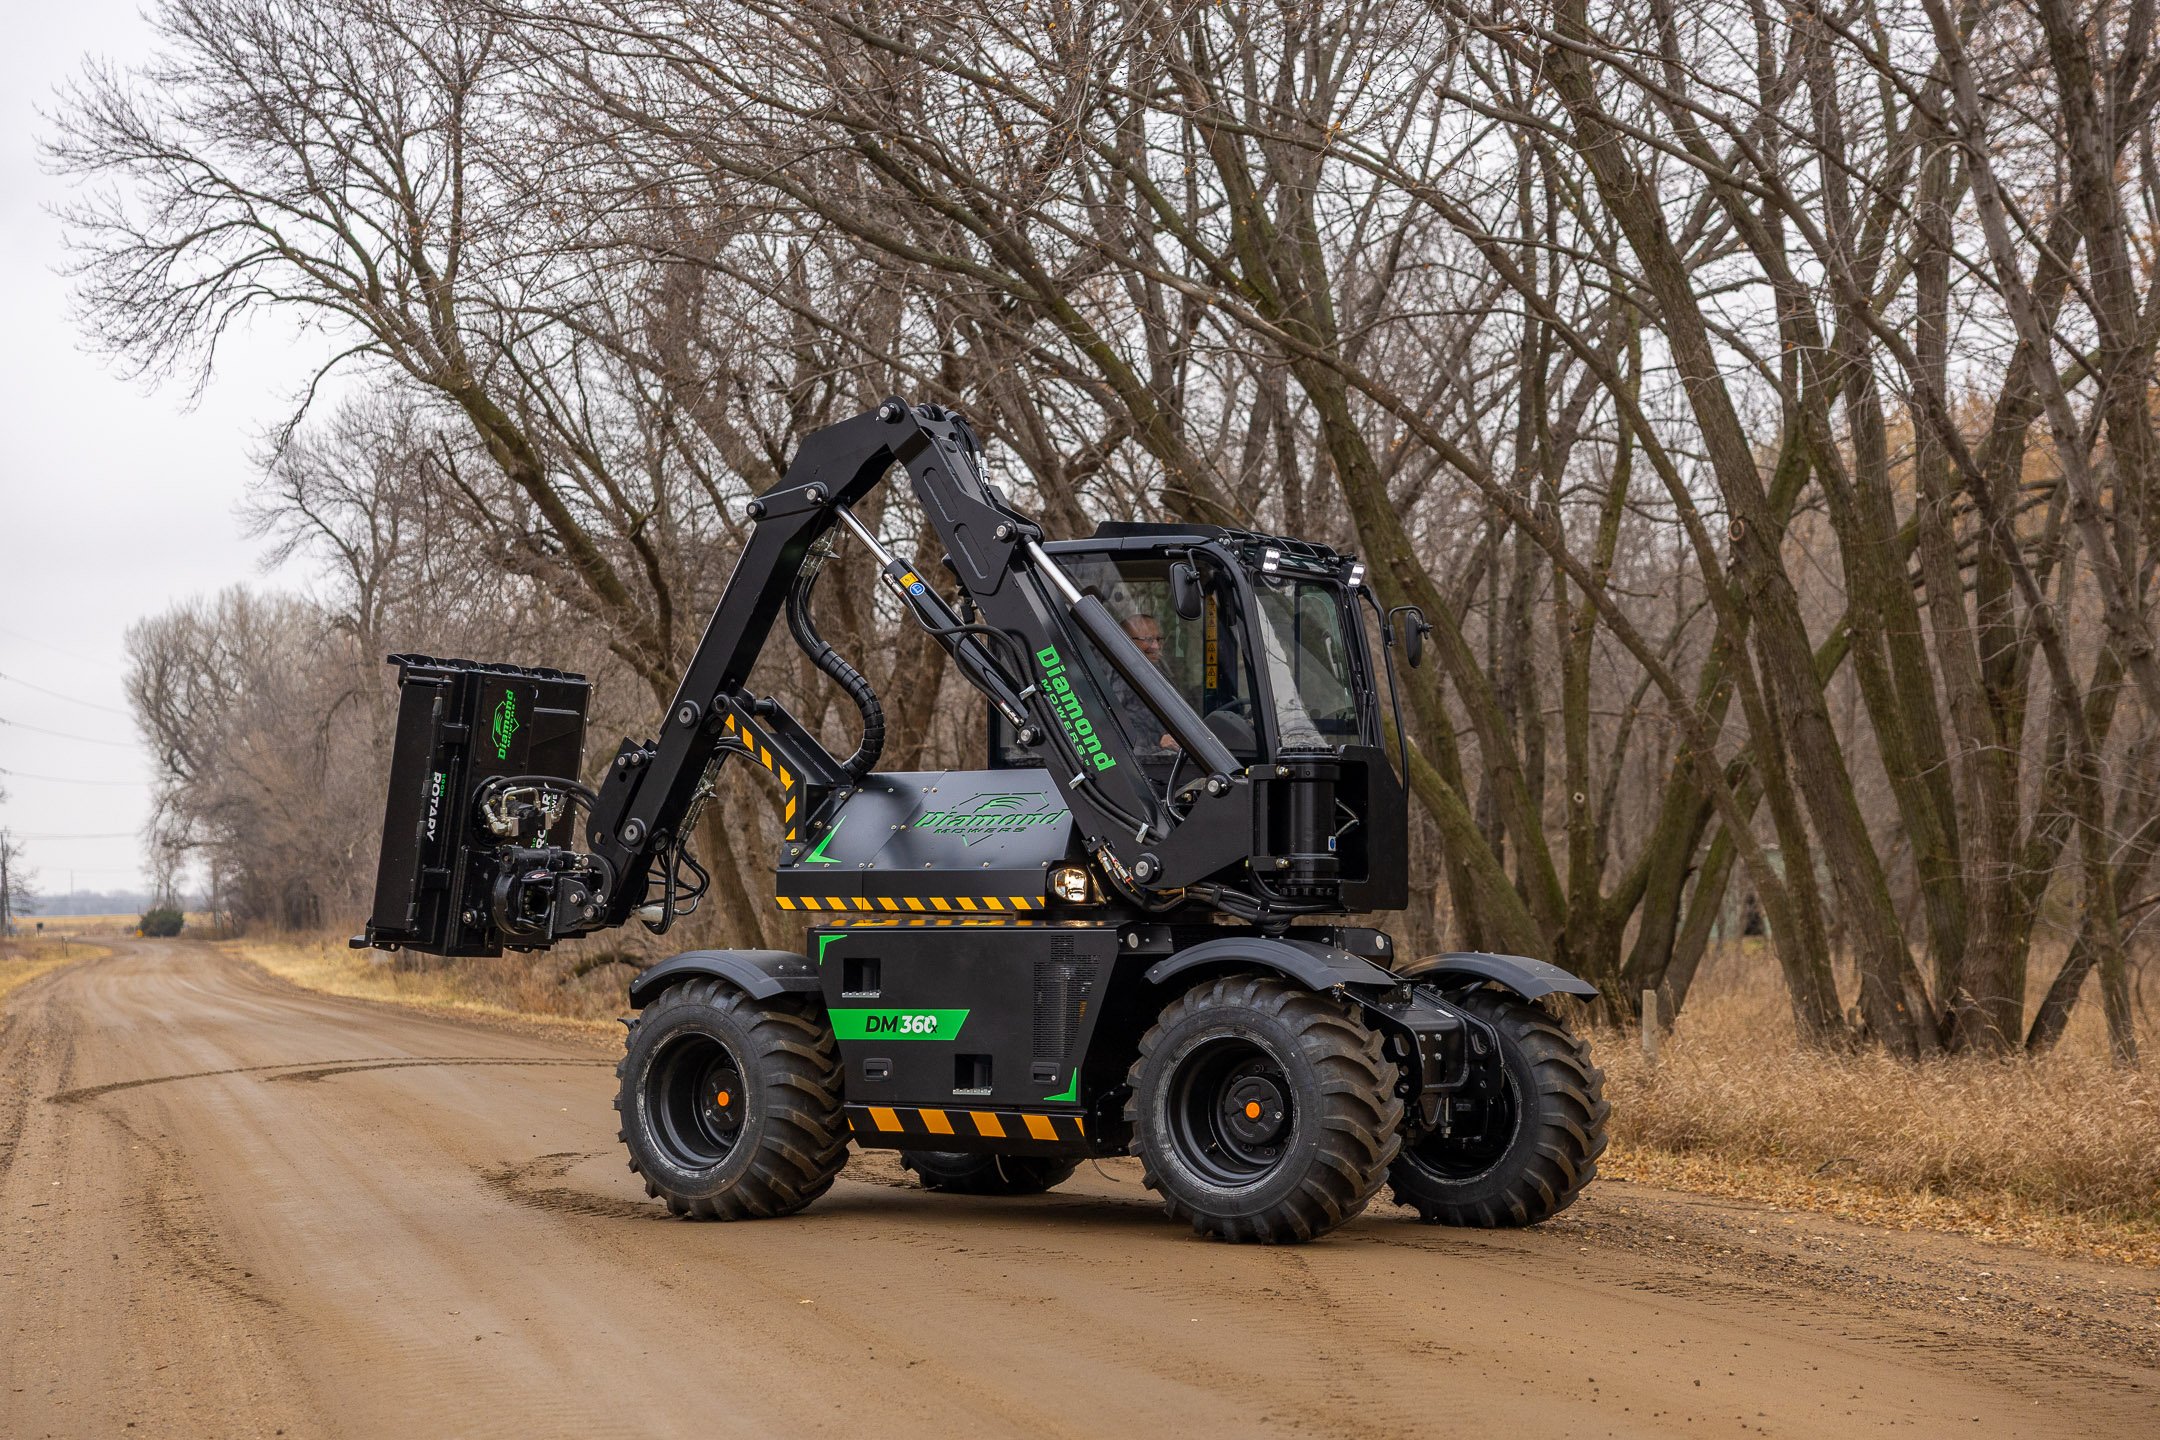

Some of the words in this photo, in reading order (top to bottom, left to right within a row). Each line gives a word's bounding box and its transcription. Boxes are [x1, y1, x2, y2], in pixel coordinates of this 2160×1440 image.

[497, 689, 514, 760] Diamond
[1036, 644, 1117, 771] Diamond
[1041, 679, 1086, 756] MOWERS
[426, 771, 442, 842] ROTARY
[914, 808, 1070, 828] Diamond
